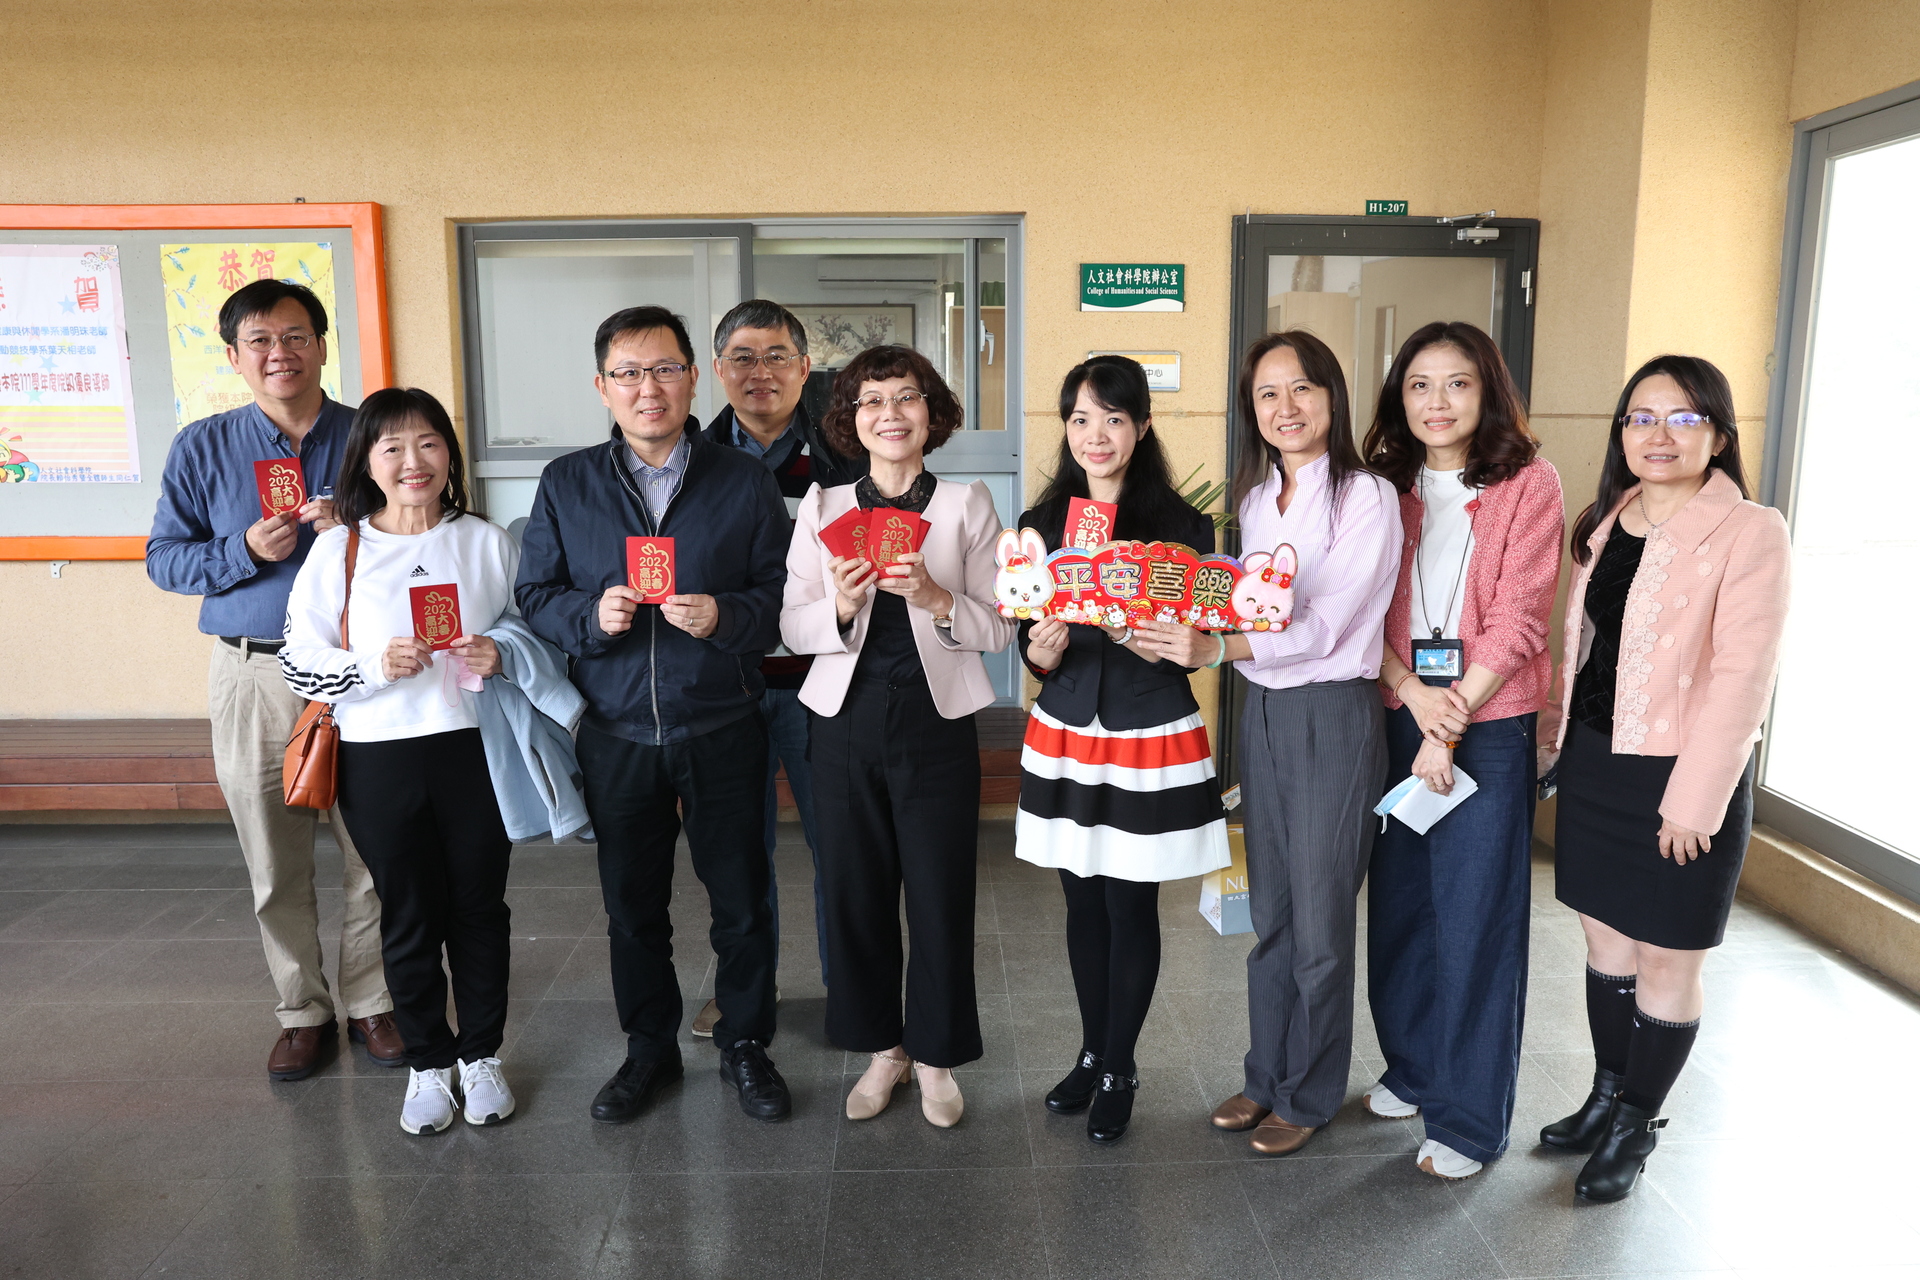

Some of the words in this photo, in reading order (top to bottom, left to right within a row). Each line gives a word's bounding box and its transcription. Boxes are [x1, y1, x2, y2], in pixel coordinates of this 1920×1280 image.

[1369, 202, 1406, 213] H1-207
[217, 248, 276, 293] 恭賀
[1087, 267, 1179, 286] 人文社會科學院辦公室
[1086, 286, 1104, 297] College
[1104, 286, 1110, 295] of
[1110, 286, 1136, 295] Humanities
[1135, 286, 1145, 295] and
[1145, 286, 1159, 295] Social
[1159, 286, 1179, 295] Sciences
[1055, 557, 1235, 609] 平安喜樂
